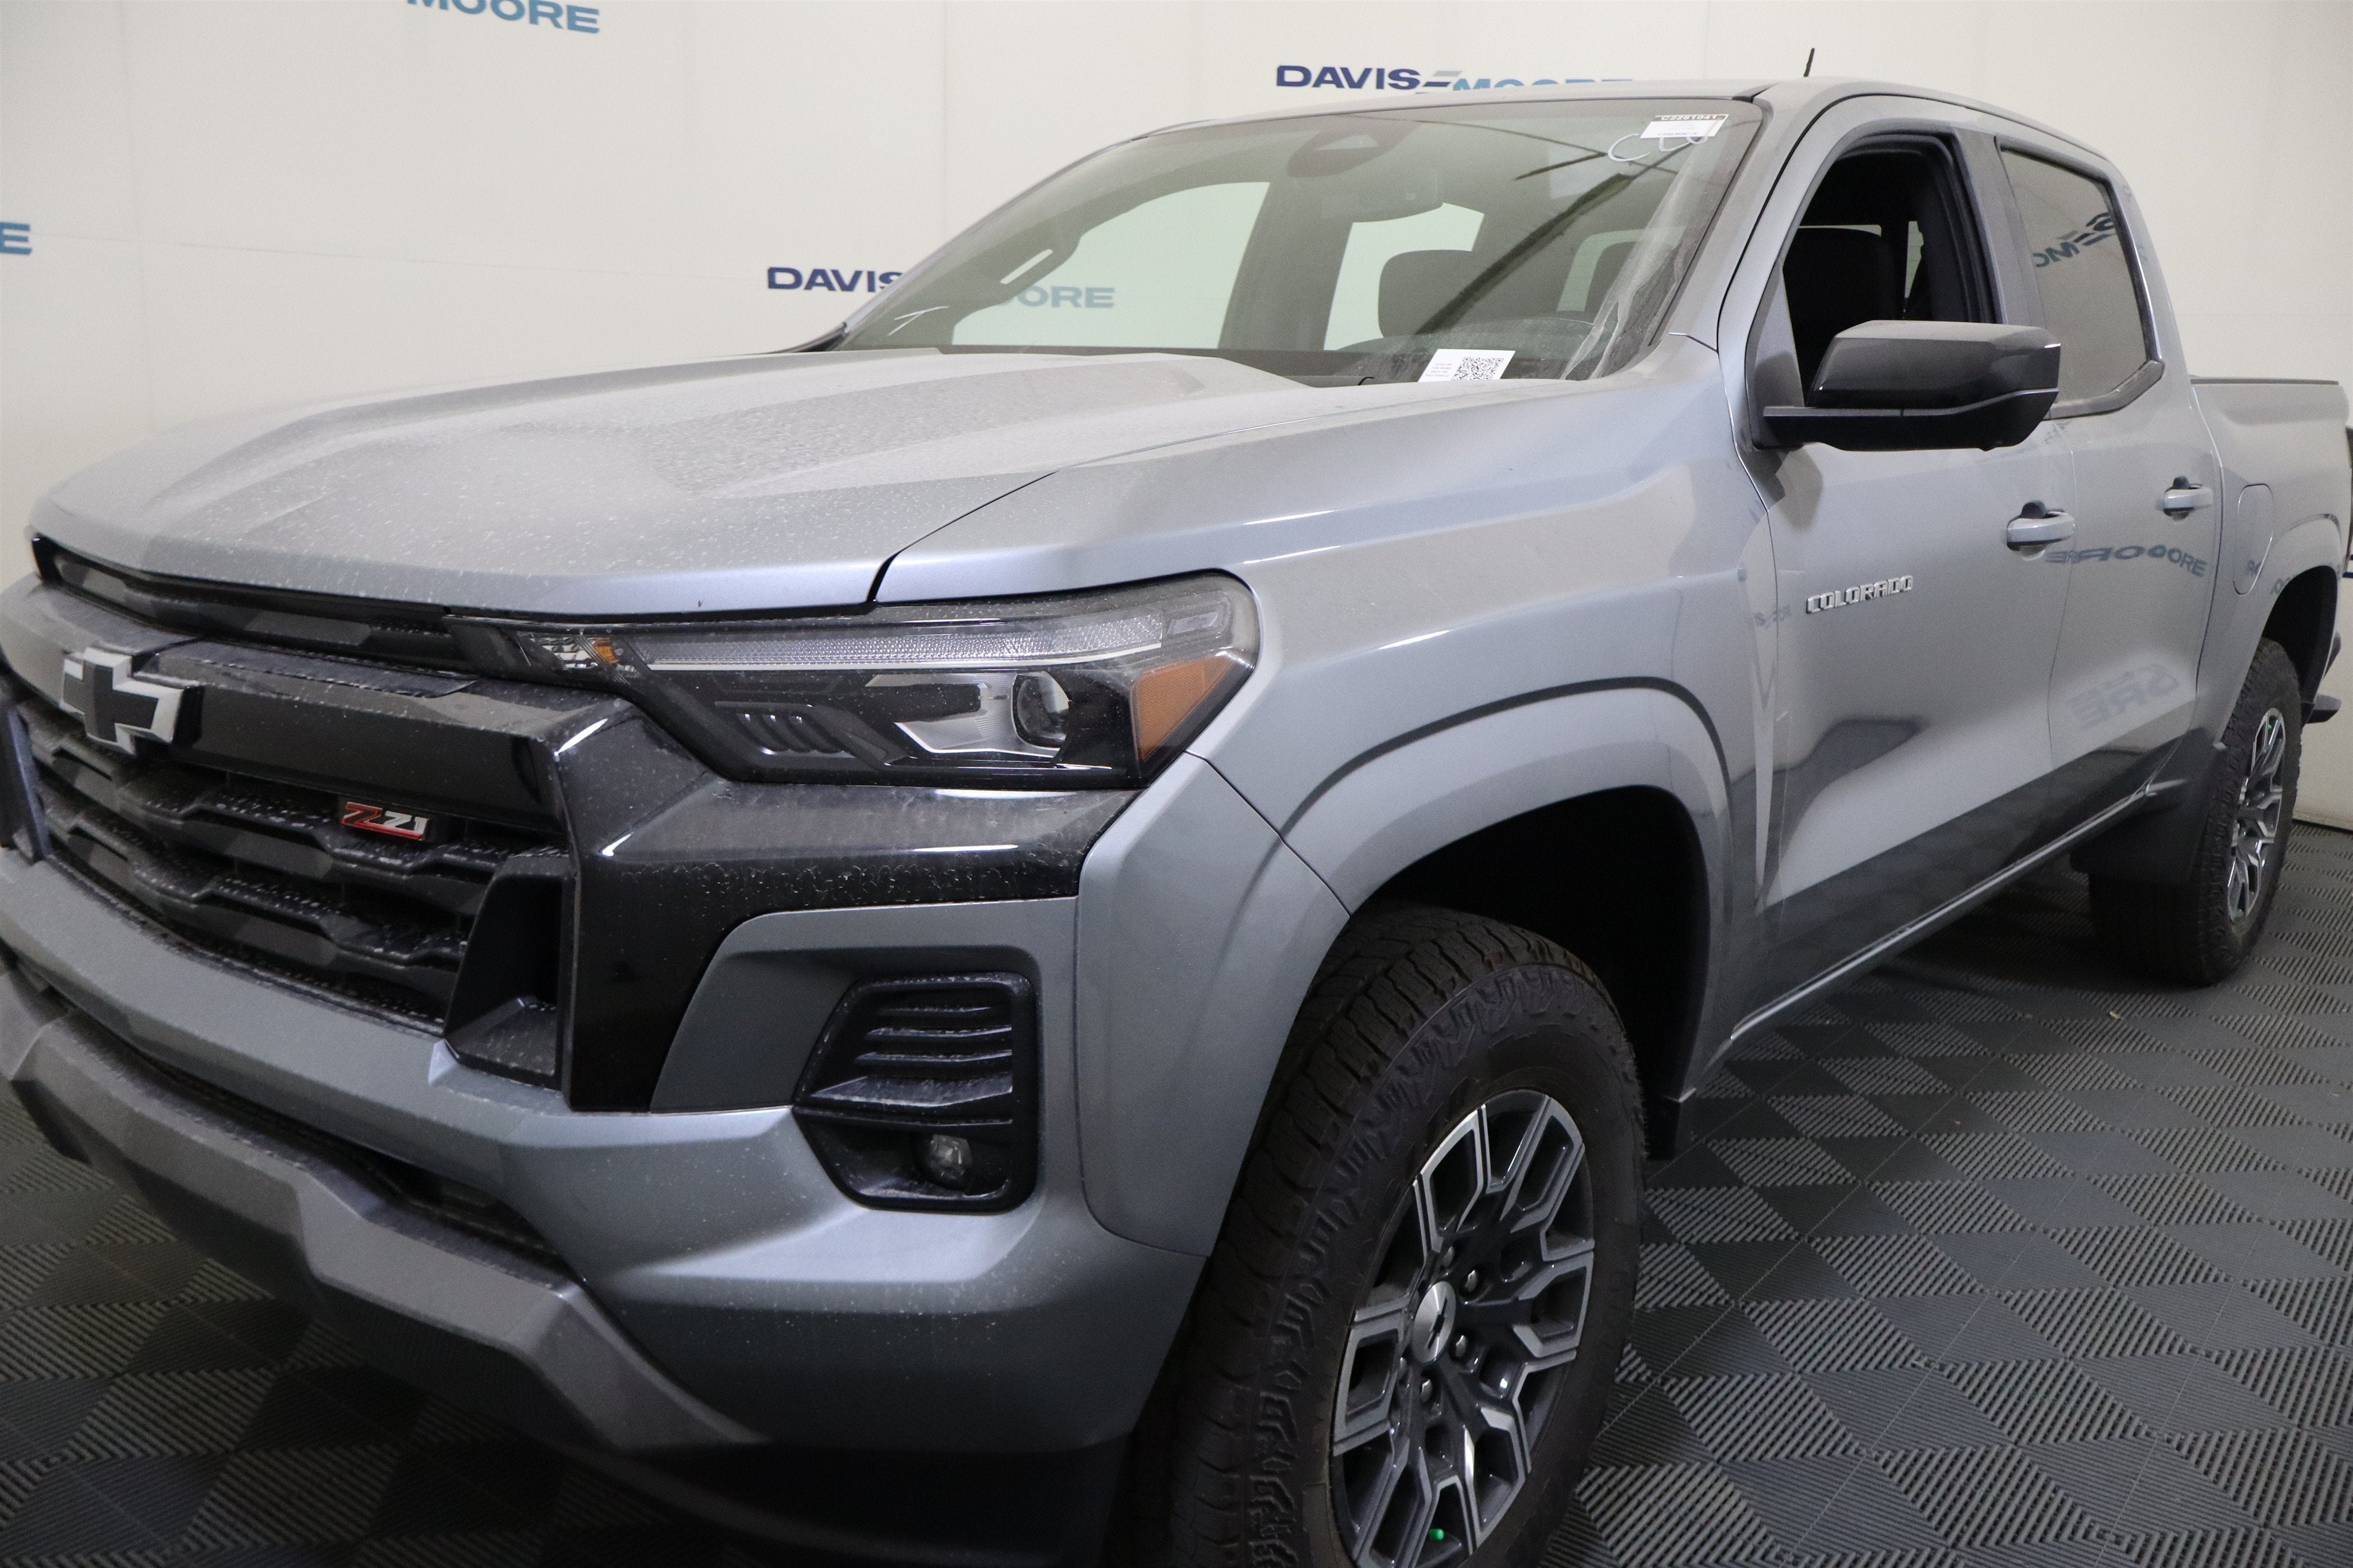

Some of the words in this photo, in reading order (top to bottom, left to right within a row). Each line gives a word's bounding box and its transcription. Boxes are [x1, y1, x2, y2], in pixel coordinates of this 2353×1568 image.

[1276, 65, 1421, 90] DAVIS
[1000, 286, 1115, 308] ORE
[1806, 575, 1914, 613] COLORADO
[341, 801, 430, 840] Z71
